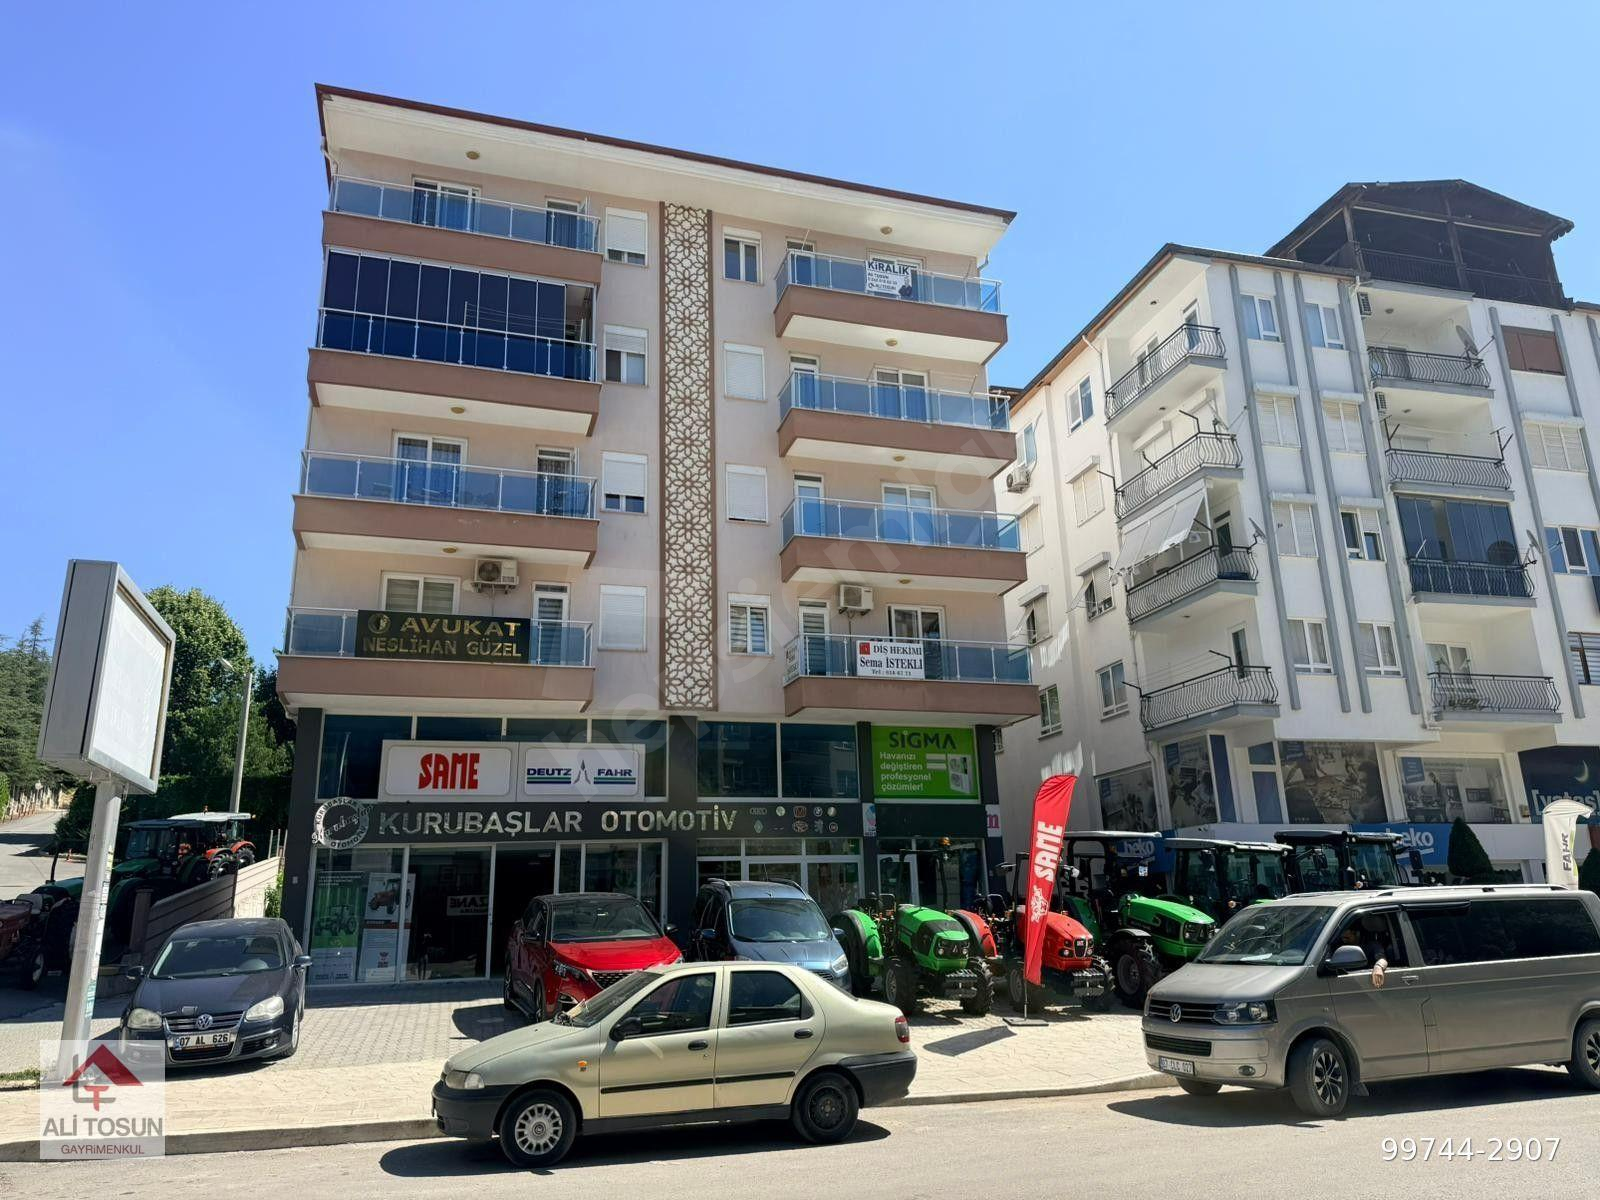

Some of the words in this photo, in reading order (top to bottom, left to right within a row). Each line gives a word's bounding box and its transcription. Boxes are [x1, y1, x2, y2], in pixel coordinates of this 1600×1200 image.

[400, 617, 521, 637] AVUKAT
[362, 634, 457, 655] NESLİHAN
[466, 637, 522, 657] GÜZEL
[873, 645, 888, 656] DİŞ
[890, 646, 922, 655] HEKİMİ
[860, 656, 883, 668] Sema
[885, 657, 923, 670] İSTEKLİ
[418, 753, 481, 790] SAME
[527, 768, 572, 776] DEUTZ
[597, 768, 632, 777] FAHR
[880, 762, 923, 772] değiştiren
[880, 773, 932, 782] profesyonel
[379, 810, 583, 837] KURUBAŞLAR
[600, 804, 738, 832] OTOMOTİV
[1387, 827, 1434, 848] eko
[1034, 820, 1063, 882] SAME
[1561, 833, 1572, 872] FAHR
[180, 1037, 191, 1046] 07
[195, 1035, 206, 1045] AL
[212, 1033, 229, 1044] 626
